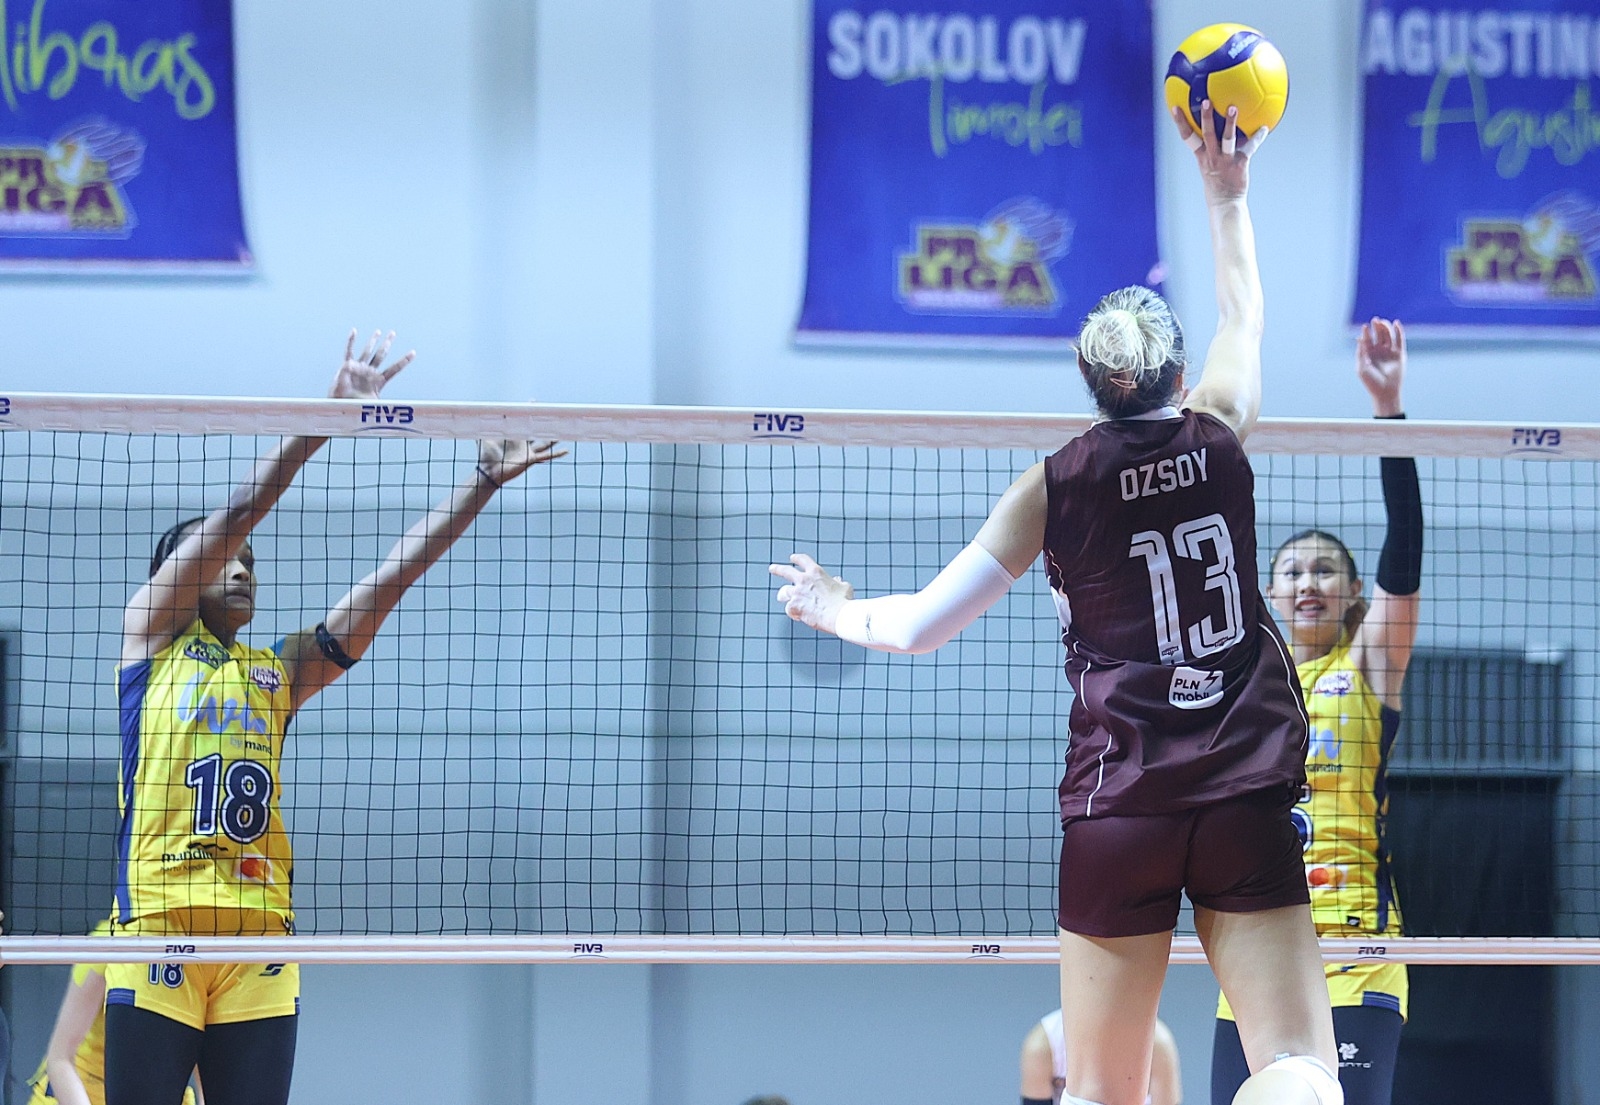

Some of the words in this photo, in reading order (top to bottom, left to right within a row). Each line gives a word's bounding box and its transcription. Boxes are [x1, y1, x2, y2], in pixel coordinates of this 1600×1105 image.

[827, 10, 1088, 85] SOKOLOV
[1362, 8, 1600, 79] AGUSTIN
[361, 405, 414, 423] FIVB
[753, 413, 804, 432] FIVB
[1512, 428, 1561, 446] FIVB
[1119, 448, 1208, 501] OZSOY
[1128, 513, 1246, 665] 13
[1174, 678, 1200, 690] PLN
[185, 753, 274, 844] 18
[165, 944, 196, 954] FIVB
[573, 943, 603, 953] FIVB
[972, 944, 1000, 954] FIVB
[1358, 946, 1386, 955] FIVB
